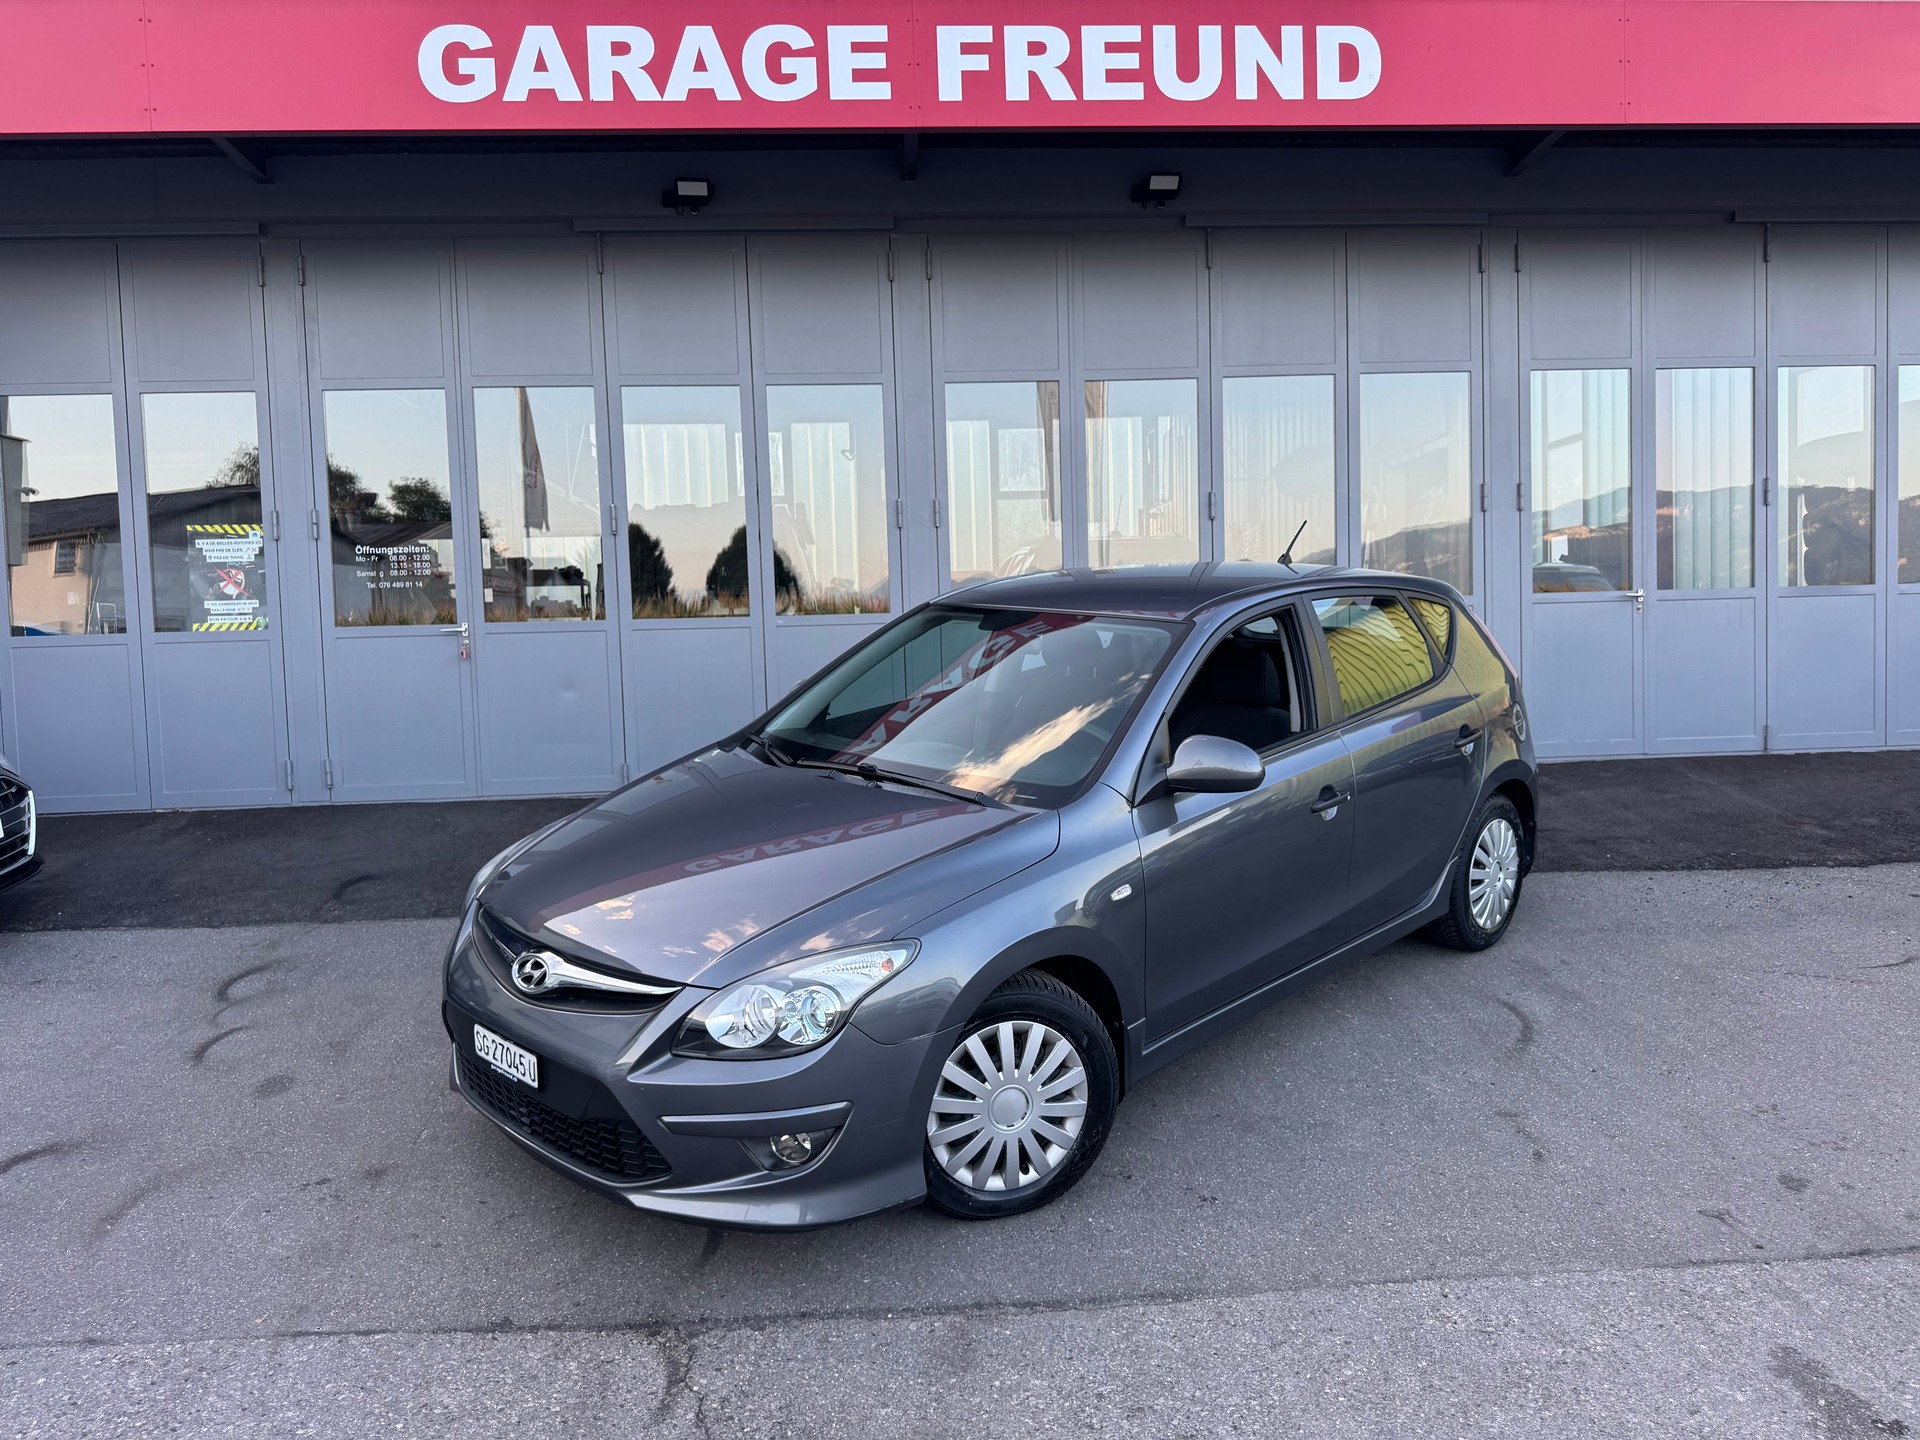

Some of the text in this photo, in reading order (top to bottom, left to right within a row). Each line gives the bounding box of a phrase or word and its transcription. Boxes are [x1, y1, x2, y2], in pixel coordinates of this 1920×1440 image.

[418, 25, 1381, 102] GARAGE FREUND
[356, 545, 430, 555] Öffnungszeiten:
